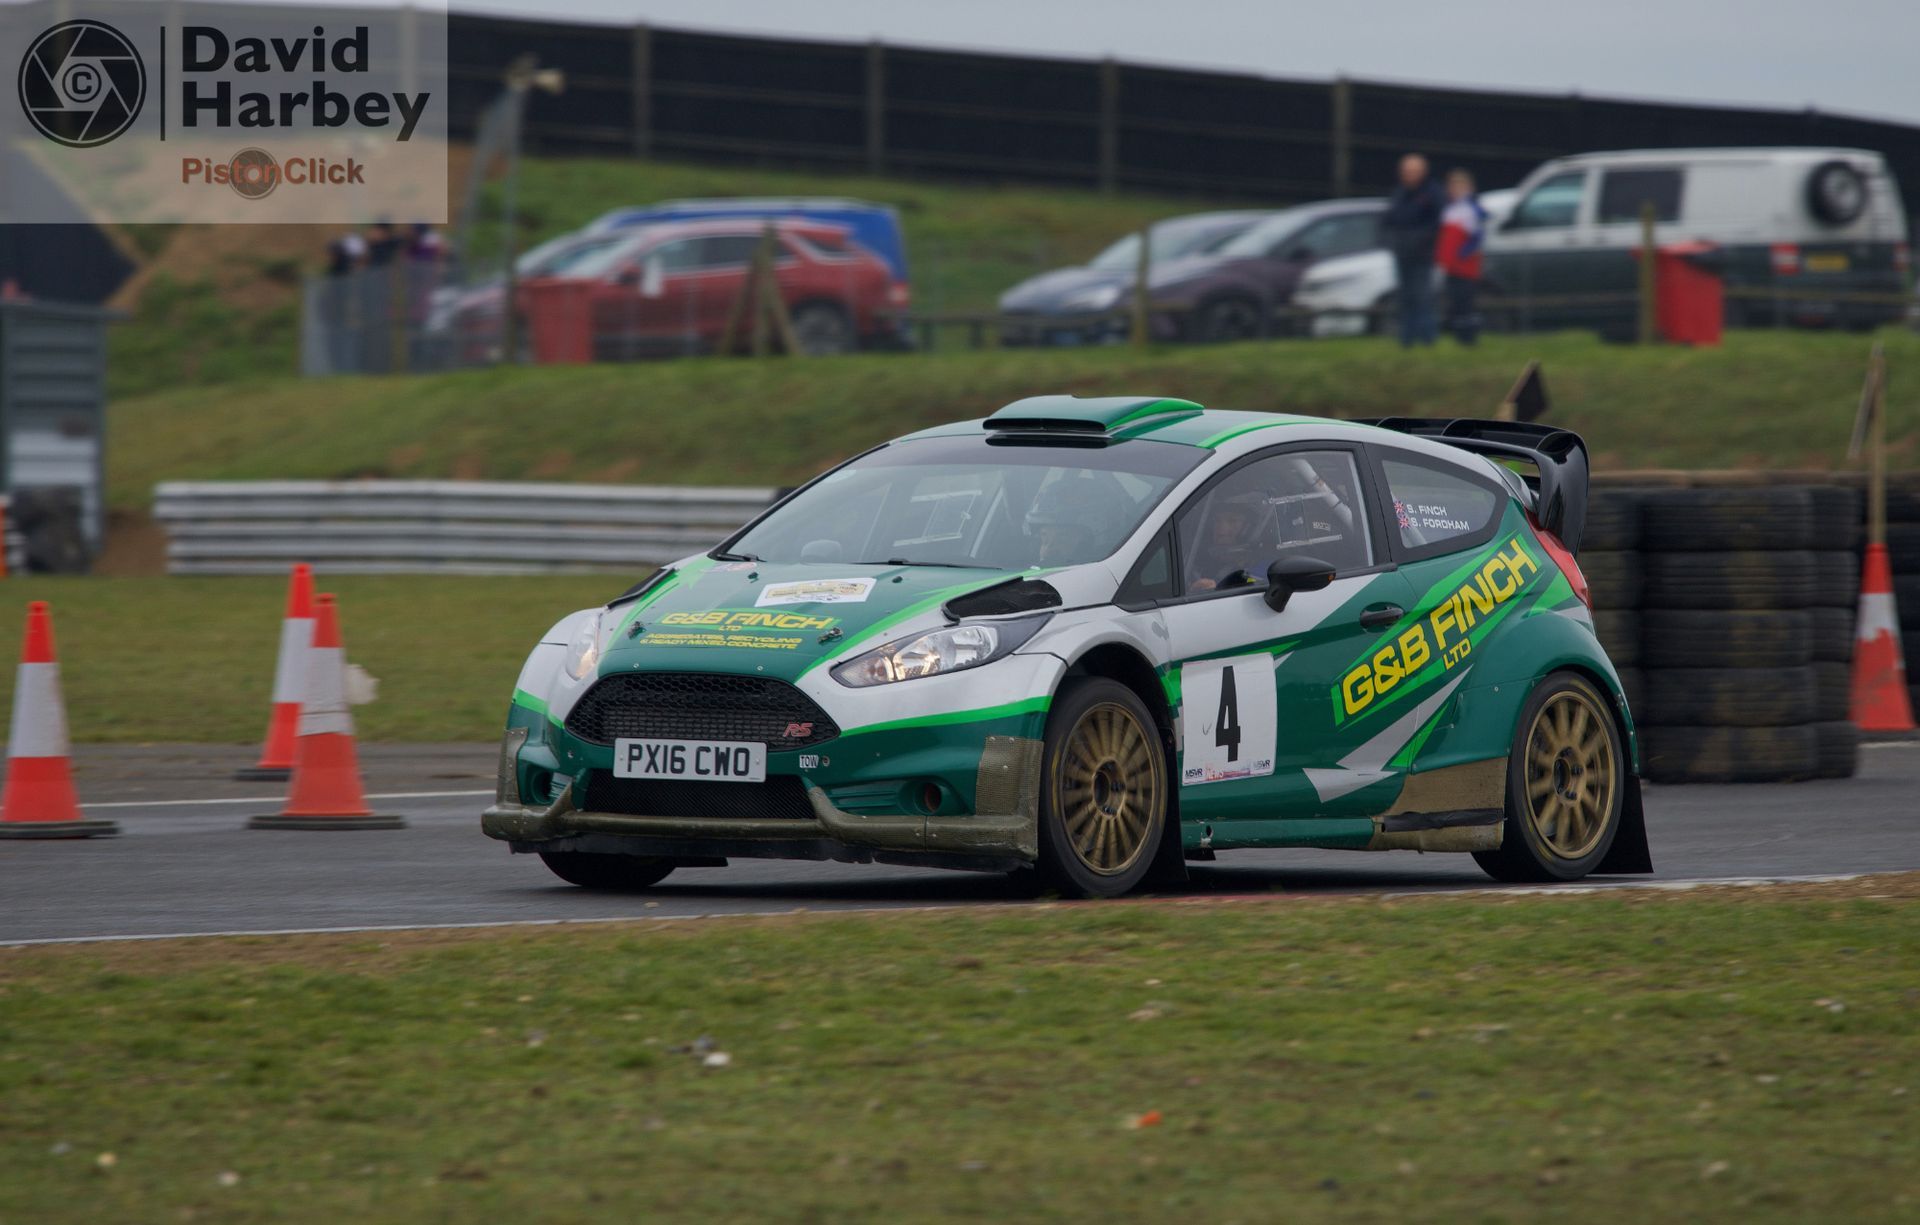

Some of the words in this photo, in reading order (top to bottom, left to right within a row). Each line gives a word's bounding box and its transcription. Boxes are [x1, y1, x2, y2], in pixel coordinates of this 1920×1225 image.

[1406, 504, 1417, 514] S.
[1418, 505, 1448, 517] FINCH
[1410, 517, 1421, 527] S.
[1423, 518, 1470, 531] FORDHAM
[661, 612, 728, 625] G&B
[727, 612, 834, 629] FINCH
[1342, 623, 1431, 715] G&B
[1429, 538, 1538, 651] FINCH
[726, 634, 803, 644] RECYCLING
[726, 641, 798, 649] CONCRETE
[1442, 637, 1471, 670] LTD
[1215, 665, 1241, 762] 4
[782, 722, 813, 737] RS
[627, 743, 686, 775] PX16
[695, 746, 751, 777] CWO
[800, 755, 818, 768] TOW
